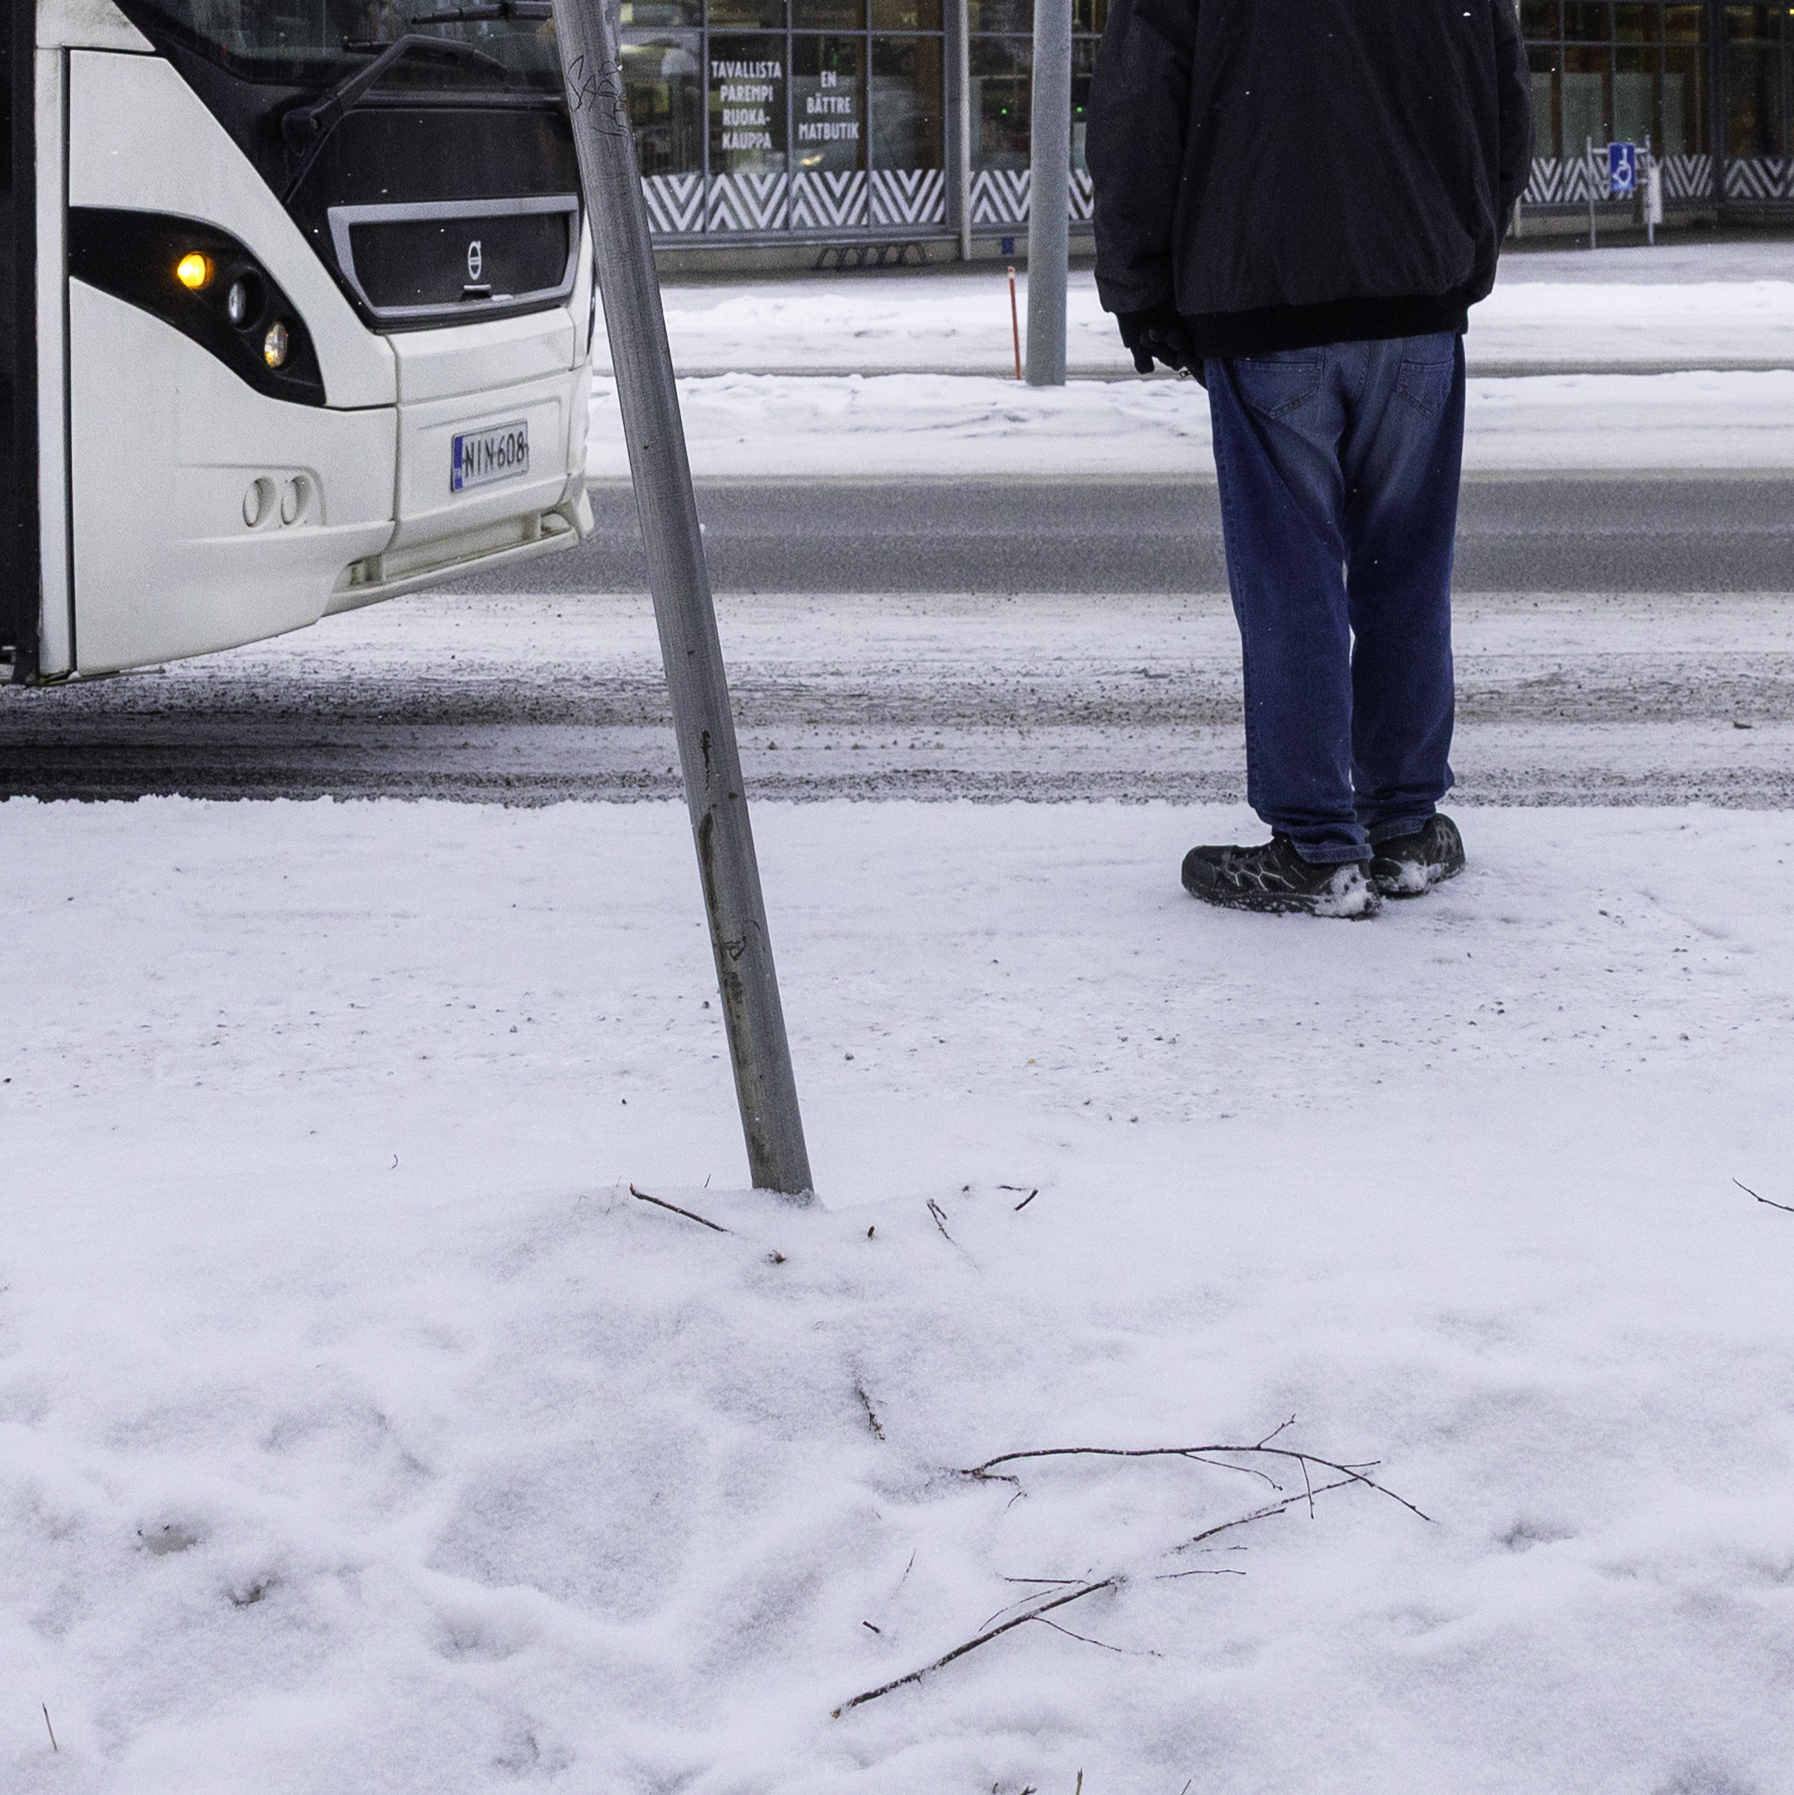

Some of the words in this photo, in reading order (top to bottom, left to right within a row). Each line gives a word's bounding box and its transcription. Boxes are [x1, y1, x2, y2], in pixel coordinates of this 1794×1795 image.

[711, 60, 783, 79] TAVALLISTA
[820, 70, 837, 89] EN
[719, 84, 774, 103] PAREMPI
[806, 92, 852, 115] BÄTTRE
[722, 108, 772, 127] RUOKA-
[798, 121, 860, 141] MATBUTIK
[722, 132, 773, 150] KAUPPA
